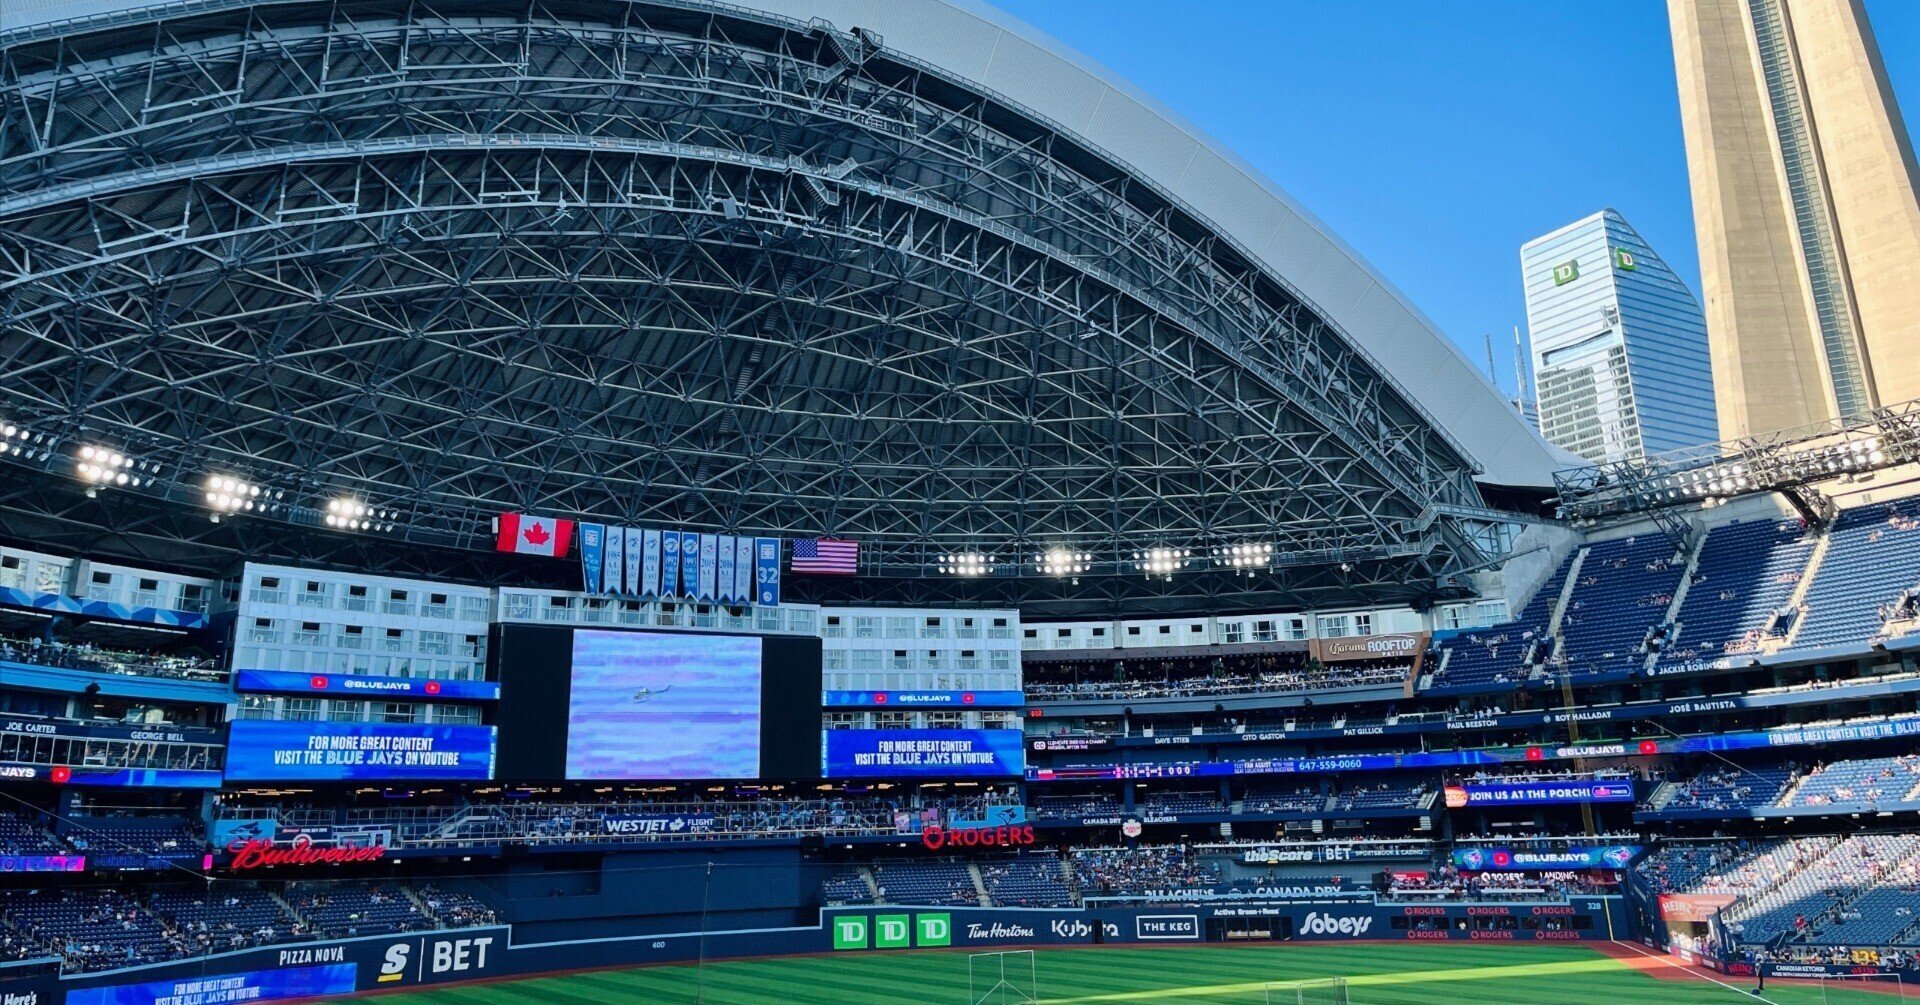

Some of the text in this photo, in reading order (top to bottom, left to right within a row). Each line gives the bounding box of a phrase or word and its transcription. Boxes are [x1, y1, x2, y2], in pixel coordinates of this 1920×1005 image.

[1556, 265, 1572, 281] TD
[758, 567, 778, 584] 32
[1329, 639, 1416, 655] Corona ROOFTOP
[1658, 660, 1730, 675] JACKIE ROBINSON
[344, 679, 411, 690] @BLUEJAYS
[1669, 700, 1736, 714] JOSÉ BAUTISTA
[1555, 711, 1612, 722] ROY HALLADAY
[6, 722, 57, 734] JOE CARTER
[1465, 719, 1498, 728] BEESTON
[131, 731, 184, 741] GEORGE BELL
[1357, 727, 1383, 735] GILLICK
[1769, 734, 1783, 745] FOR
[1784, 732, 1803, 743] MORE
[1804, 730, 1826, 741] GREAT
[1827, 728, 1858, 740] CONTENT
[1860, 725, 1878, 737] VISIT
[1880, 724, 1893, 735] THE
[309, 736, 433, 751] FOR MORE GREAT CONTENT
[879, 741, 972, 752] FOR MORE GREAT CONTENT
[1557, 745, 1625, 757] @BLUEJAYS
[274, 750, 459, 766] VISIT THE BLUE JAYS ON YOUTUBE
[855, 753, 993, 765] VISIT THE BLUE JAYS ON YOUTUBE
[1299, 759, 1362, 771] 647-559-0060
[0, 767, 36, 778] JAYS
[1470, 791, 1492, 800] JOIN
[1495, 791, 1507, 800] US
[1511, 790, 1525, 799] AT
[1527, 789, 1546, 798] THE
[606, 818, 715, 834] WESTJET FLIGHT
[950, 825, 1035, 846] ROGERS
[227, 838, 388, 869] Budweiser
[1245, 847, 1351, 862] theScore BET
[1514, 853, 1590, 862] @BLUEJAYS
[1413, 907, 1445, 915] ROGERS
[1477, 907, 1509, 915] ROGERS
[1542, 907, 1576, 915] ROGERS
[1587, 902, 1602, 910] 328
[920, 919, 947, 939] TD
[1144, 922, 1190, 931] THE KEG
[1300, 912, 1372, 936] Sobeys
[838, 922, 864, 941] TD
[879, 921, 906, 940] TD
[967, 922, 1034, 939] Tim Hortons
[1417, 931, 1448, 939] ROGERS
[1480, 931, 1513, 939] ROGERS
[1546, 931, 1579, 939] ROGERS
[652, 941, 665, 949] 400
[279, 946, 344, 966] PIZZA NOVA
[380, 937, 493, 974] S BET
[1728, 963, 1753, 974] HEINZ
[174, 983, 186, 995] FOR
[203, 980, 220, 992] GREAT
[220, 977, 245, 990] CONTENT
[205, 990, 227, 1003] JAYS
